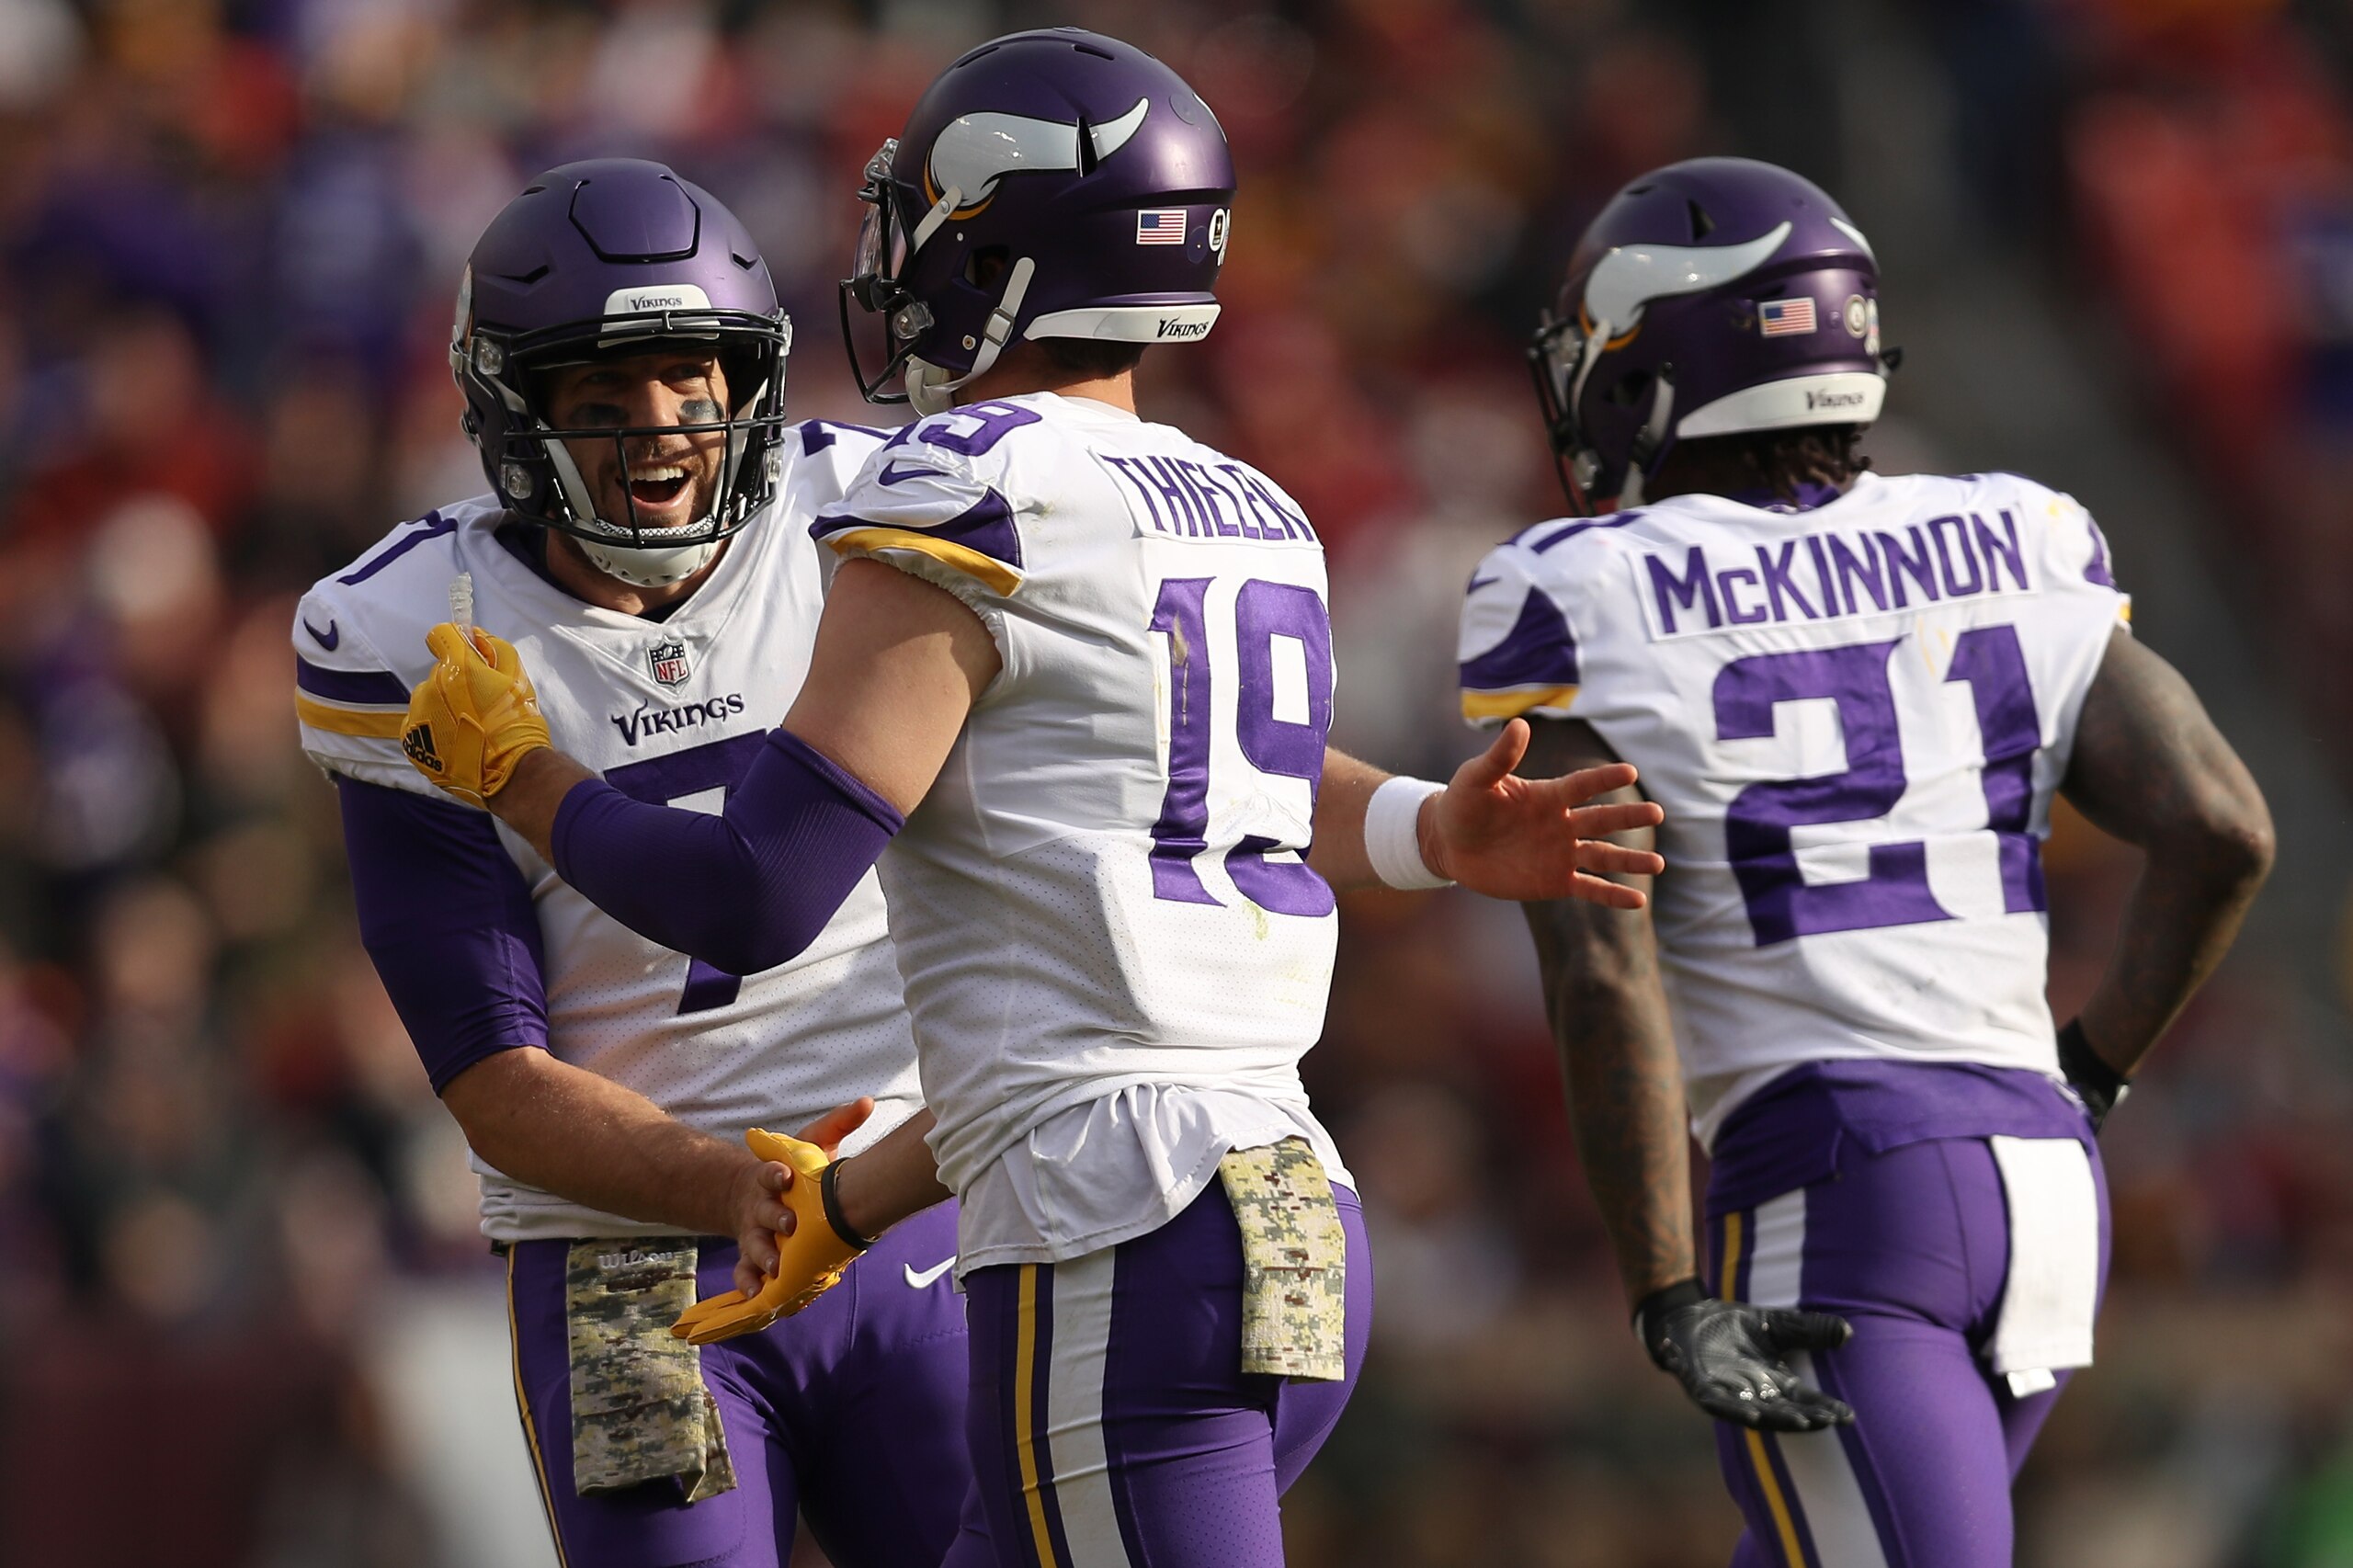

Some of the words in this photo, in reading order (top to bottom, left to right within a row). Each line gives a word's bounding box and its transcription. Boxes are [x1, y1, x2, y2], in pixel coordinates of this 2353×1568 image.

[631, 294, 682, 312] VIKINGS
[1098, 455, 1314, 542] THIELEN
[1644, 509, 2029, 634] McKINNON
[655, 660, 688, 681] NFL
[402, 738, 443, 772] adidas
[611, 693, 745, 747] VIKINGS
[1147, 576, 1336, 917] 19
[1712, 624, 2048, 948] 21
